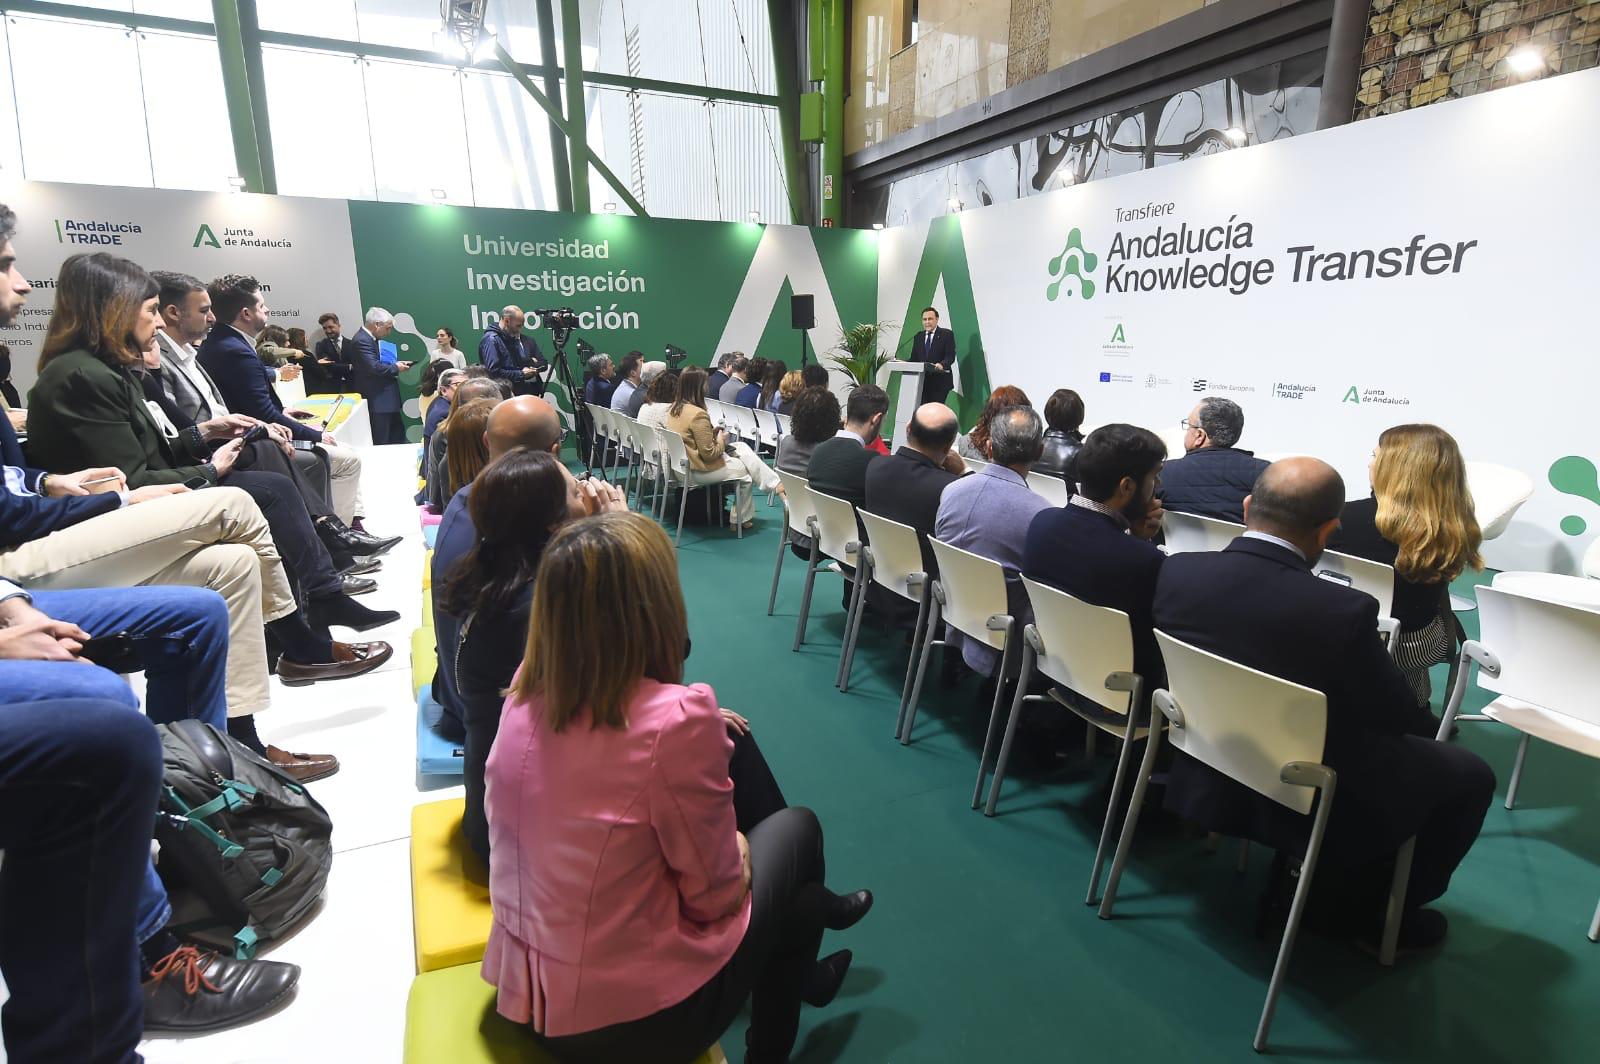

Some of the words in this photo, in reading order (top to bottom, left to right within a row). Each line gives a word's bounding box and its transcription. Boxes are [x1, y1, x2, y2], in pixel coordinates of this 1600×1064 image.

[1115, 201, 1175, 223] Transfiere
[66, 233, 122, 245] TRADE
[223, 227, 254, 237] Junta
[1106, 215, 1254, 262] Andalucía
[224, 237, 237, 246] de
[240, 238, 292, 248] Andalucía
[463, 234, 609, 259] Universidad
[1105, 254, 1274, 295] Knowledge
[1287, 234, 1478, 283] Transfer
[466, 267, 646, 297] Investigación
[1276, 391, 1304, 400] TRADE
[1363, 388, 1385, 396] Junta
